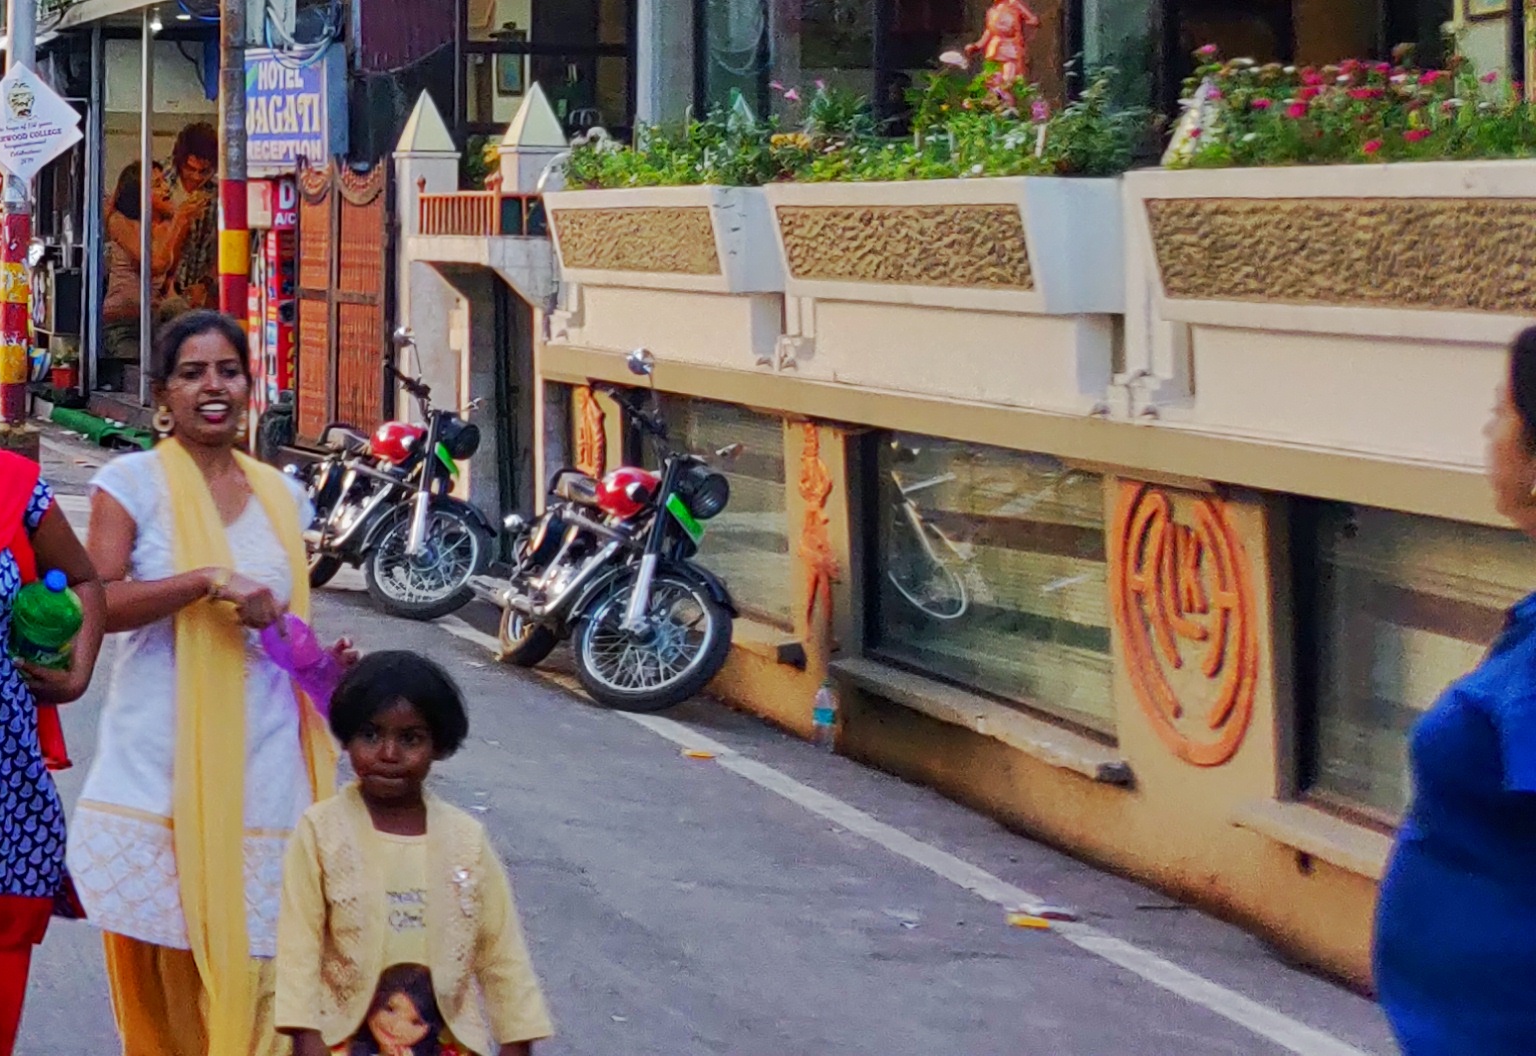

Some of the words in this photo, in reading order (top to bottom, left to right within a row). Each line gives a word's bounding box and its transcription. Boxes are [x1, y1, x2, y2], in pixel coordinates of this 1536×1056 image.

[257, 60, 305, 92] HOTEL
[245, 93, 321, 135] JAGATI
[247, 139, 322, 162] RECEPTION
